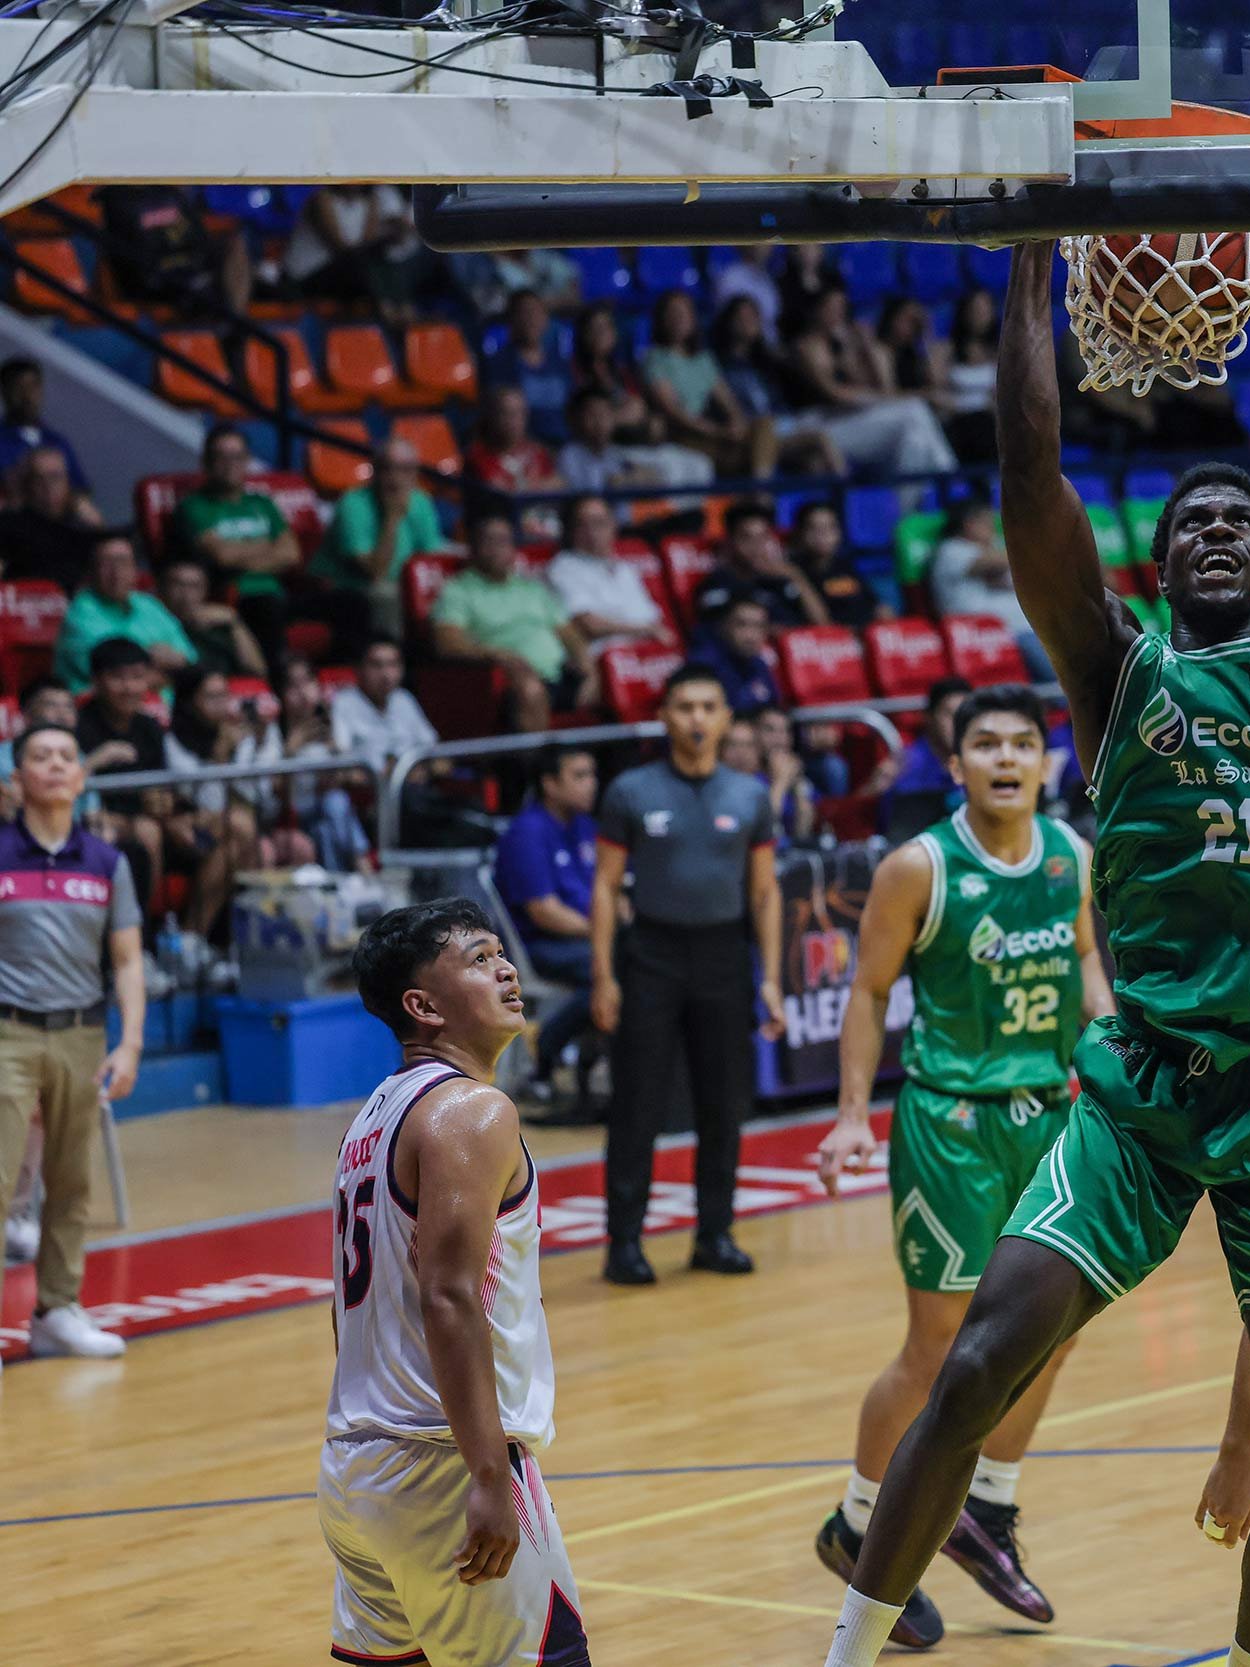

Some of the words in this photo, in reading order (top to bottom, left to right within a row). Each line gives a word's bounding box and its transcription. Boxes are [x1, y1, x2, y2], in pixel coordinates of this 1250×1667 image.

[1171, 760, 1208, 786] La
[1006, 921, 1076, 957] EcoO
[1000, 984, 1059, 1036] 32
